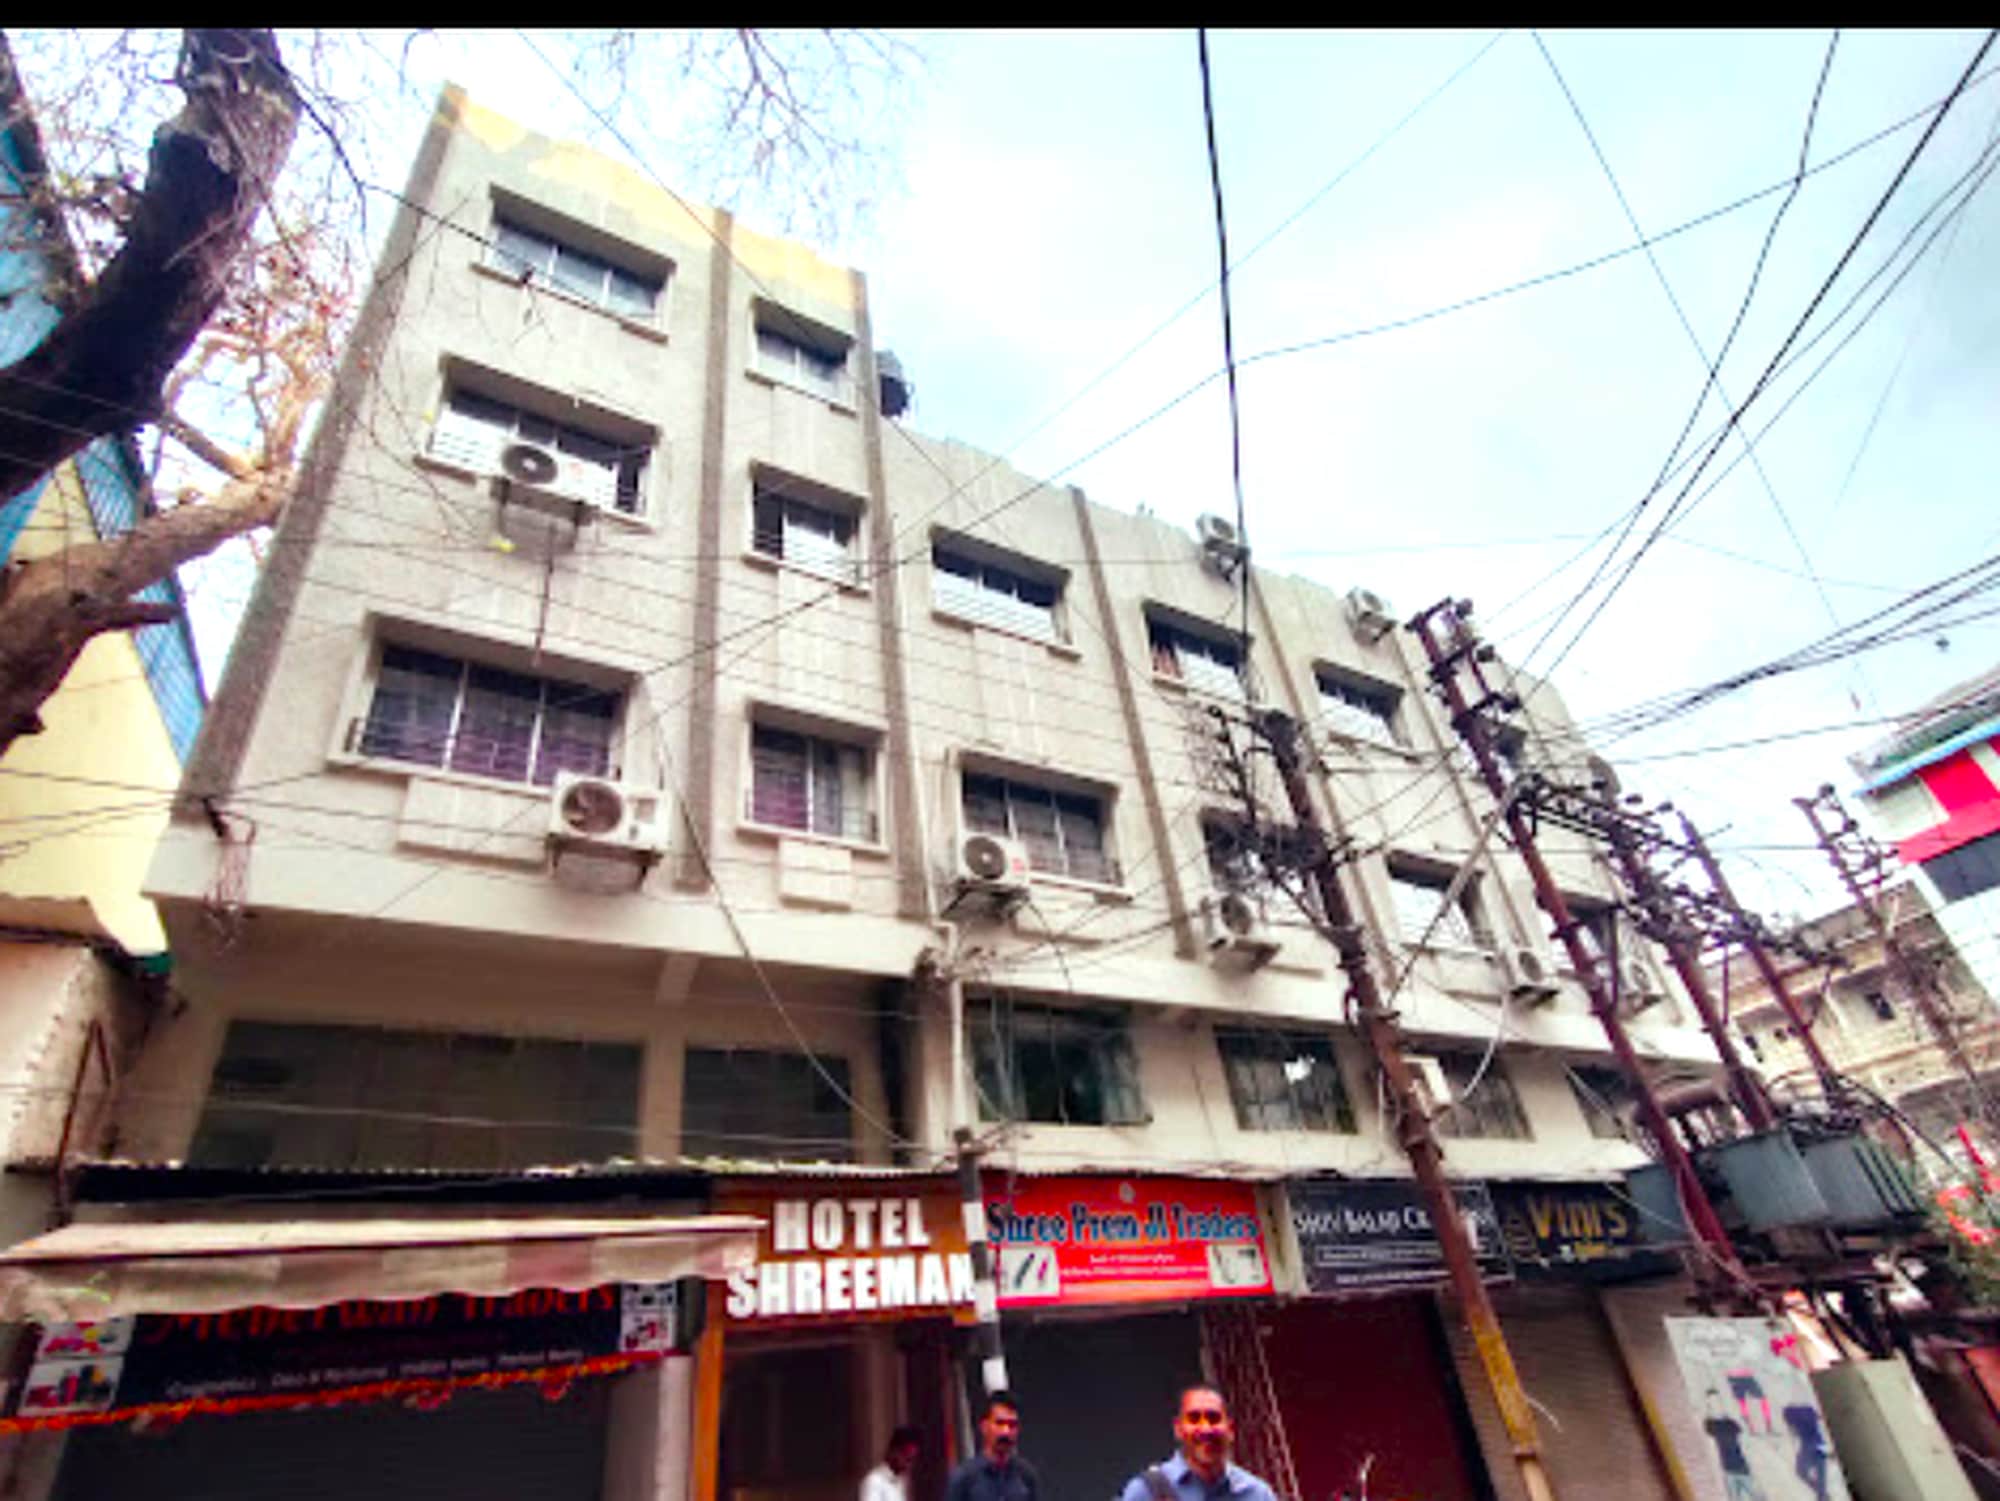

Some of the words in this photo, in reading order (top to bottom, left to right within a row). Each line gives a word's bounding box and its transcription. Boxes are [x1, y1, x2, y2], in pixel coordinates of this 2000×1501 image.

[772, 1197, 931, 1251] HOTEL
[981, 1200, 1066, 1244] Shree
[1070, 1201, 1140, 1243] Prem
[1171, 1201, 1260, 1241] Traders
[726, 1252, 976, 1318] SHREEMAN
